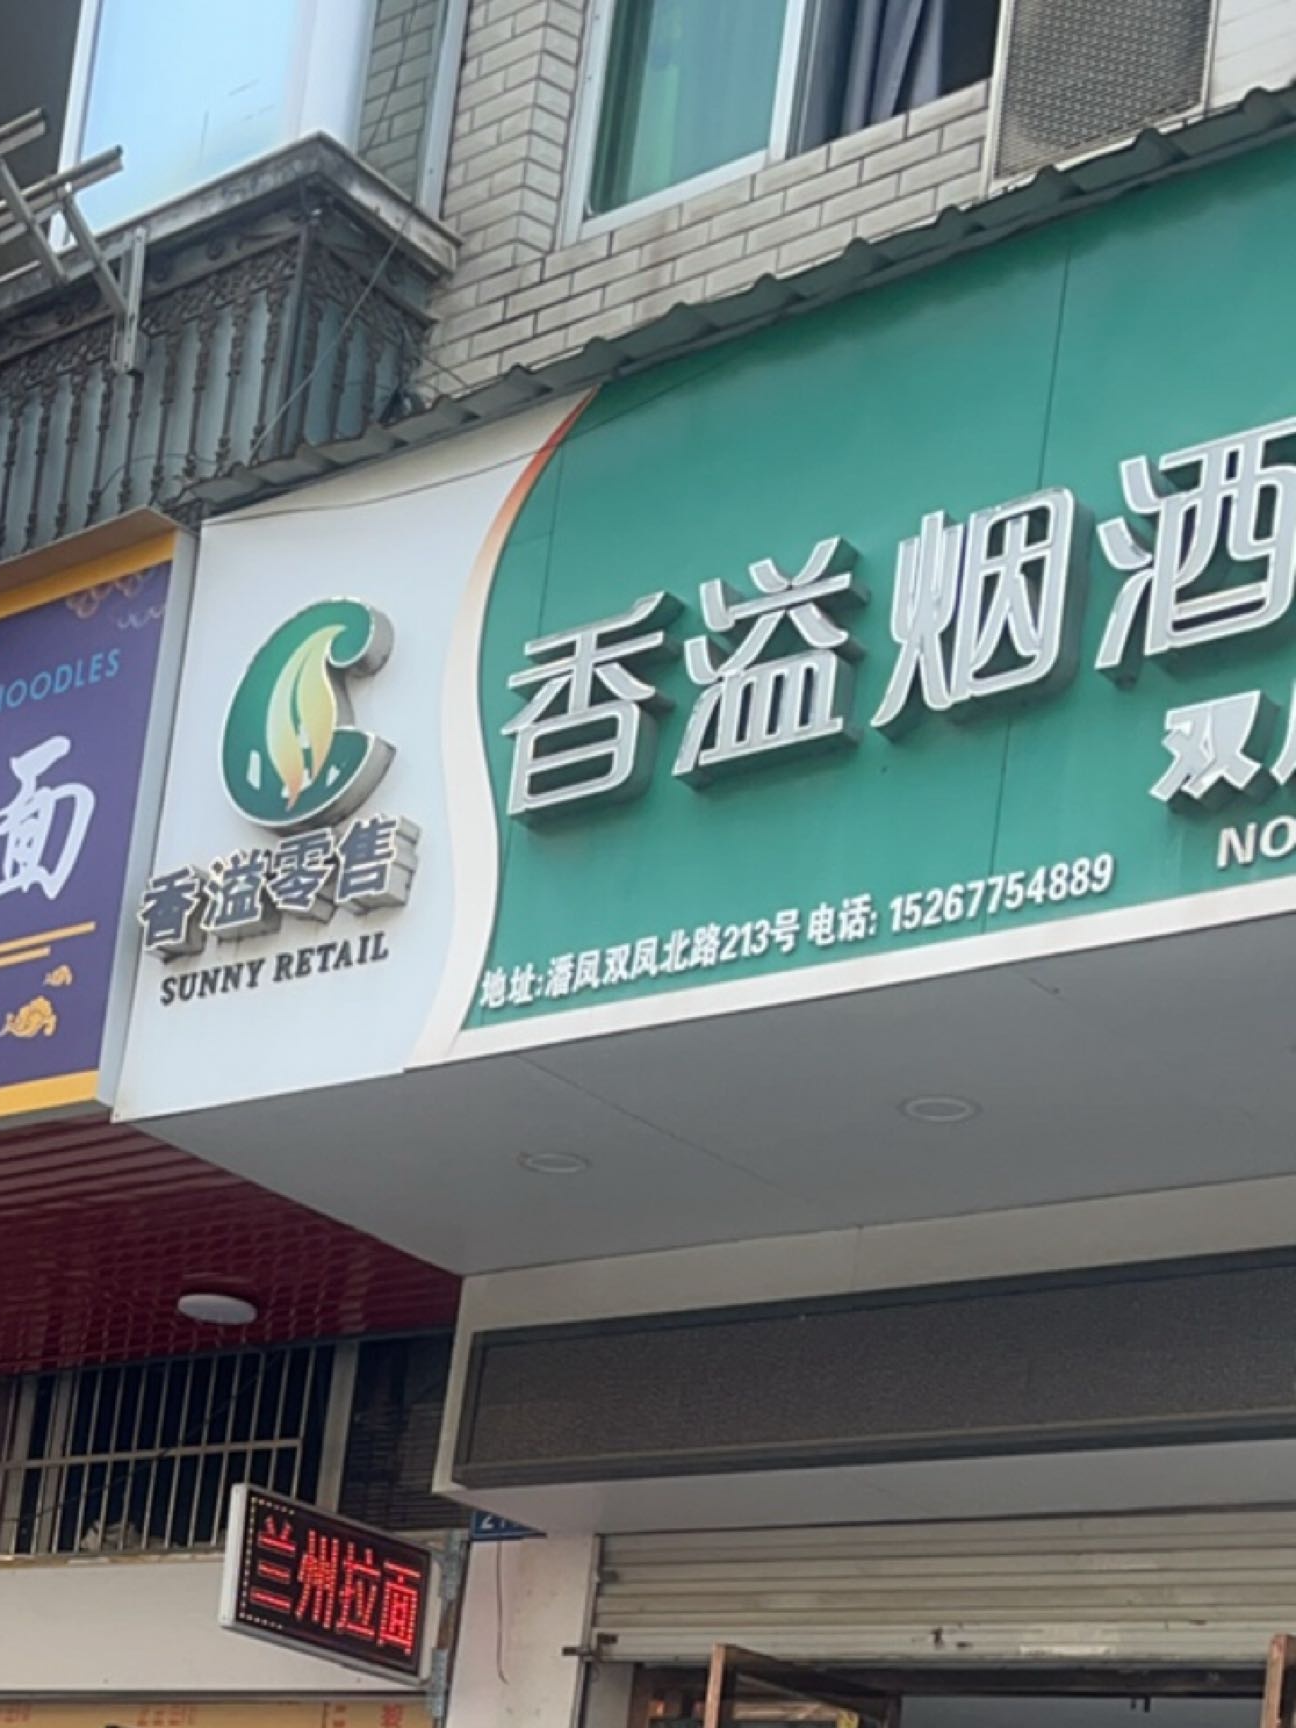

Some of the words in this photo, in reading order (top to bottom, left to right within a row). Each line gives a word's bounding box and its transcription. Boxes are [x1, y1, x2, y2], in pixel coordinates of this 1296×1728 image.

[501, 418, 1296, 816] 香溢烟酒
[1150, 685, 1296, 801] 双
[138, 815, 401, 950] 香溢零售
[890, 852, 1115, 932] 15267754889
[160, 959, 267, 1006] SUNNY
[273, 932, 390, 984] RETAIL
[249, 1514, 422, 1657] 兰州拉面
